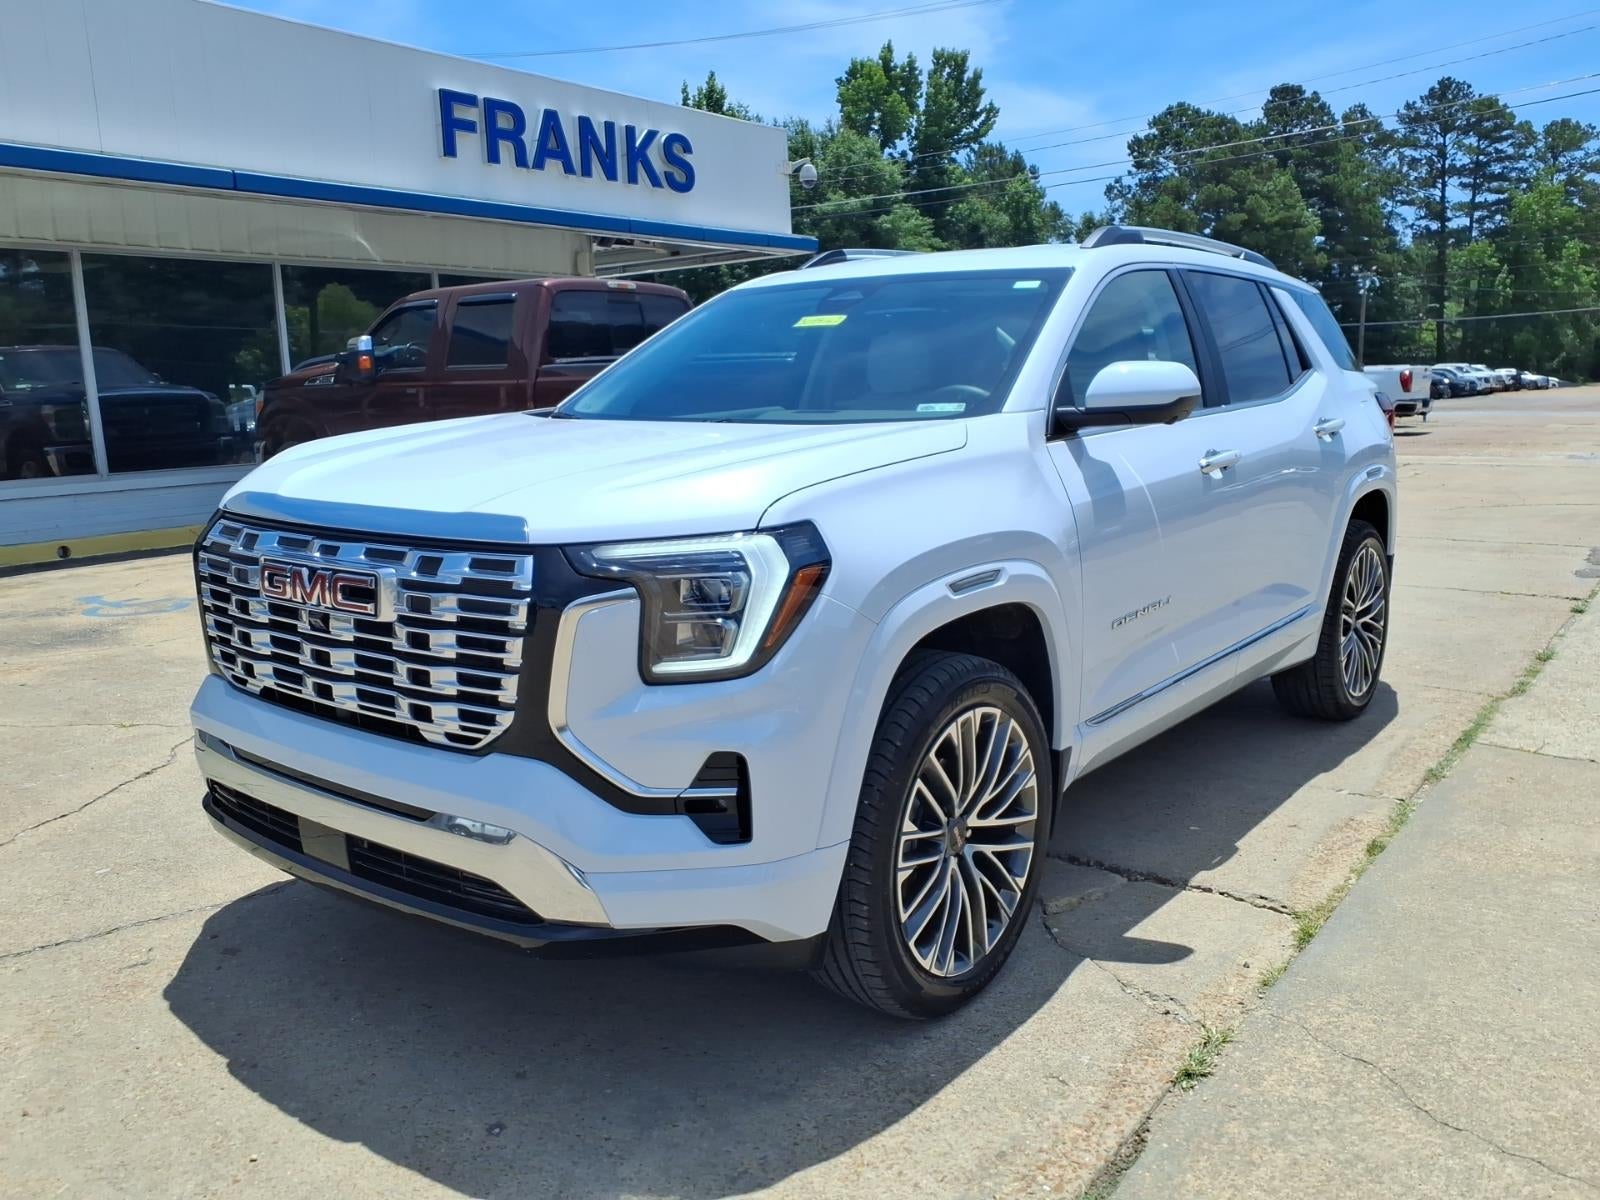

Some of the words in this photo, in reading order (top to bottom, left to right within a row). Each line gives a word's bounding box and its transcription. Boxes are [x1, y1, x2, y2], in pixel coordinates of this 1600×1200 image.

[438, 88, 696, 193] FRANKS
[260, 562, 375, 615] GMC
[1111, 594, 1172, 630] DENALI
